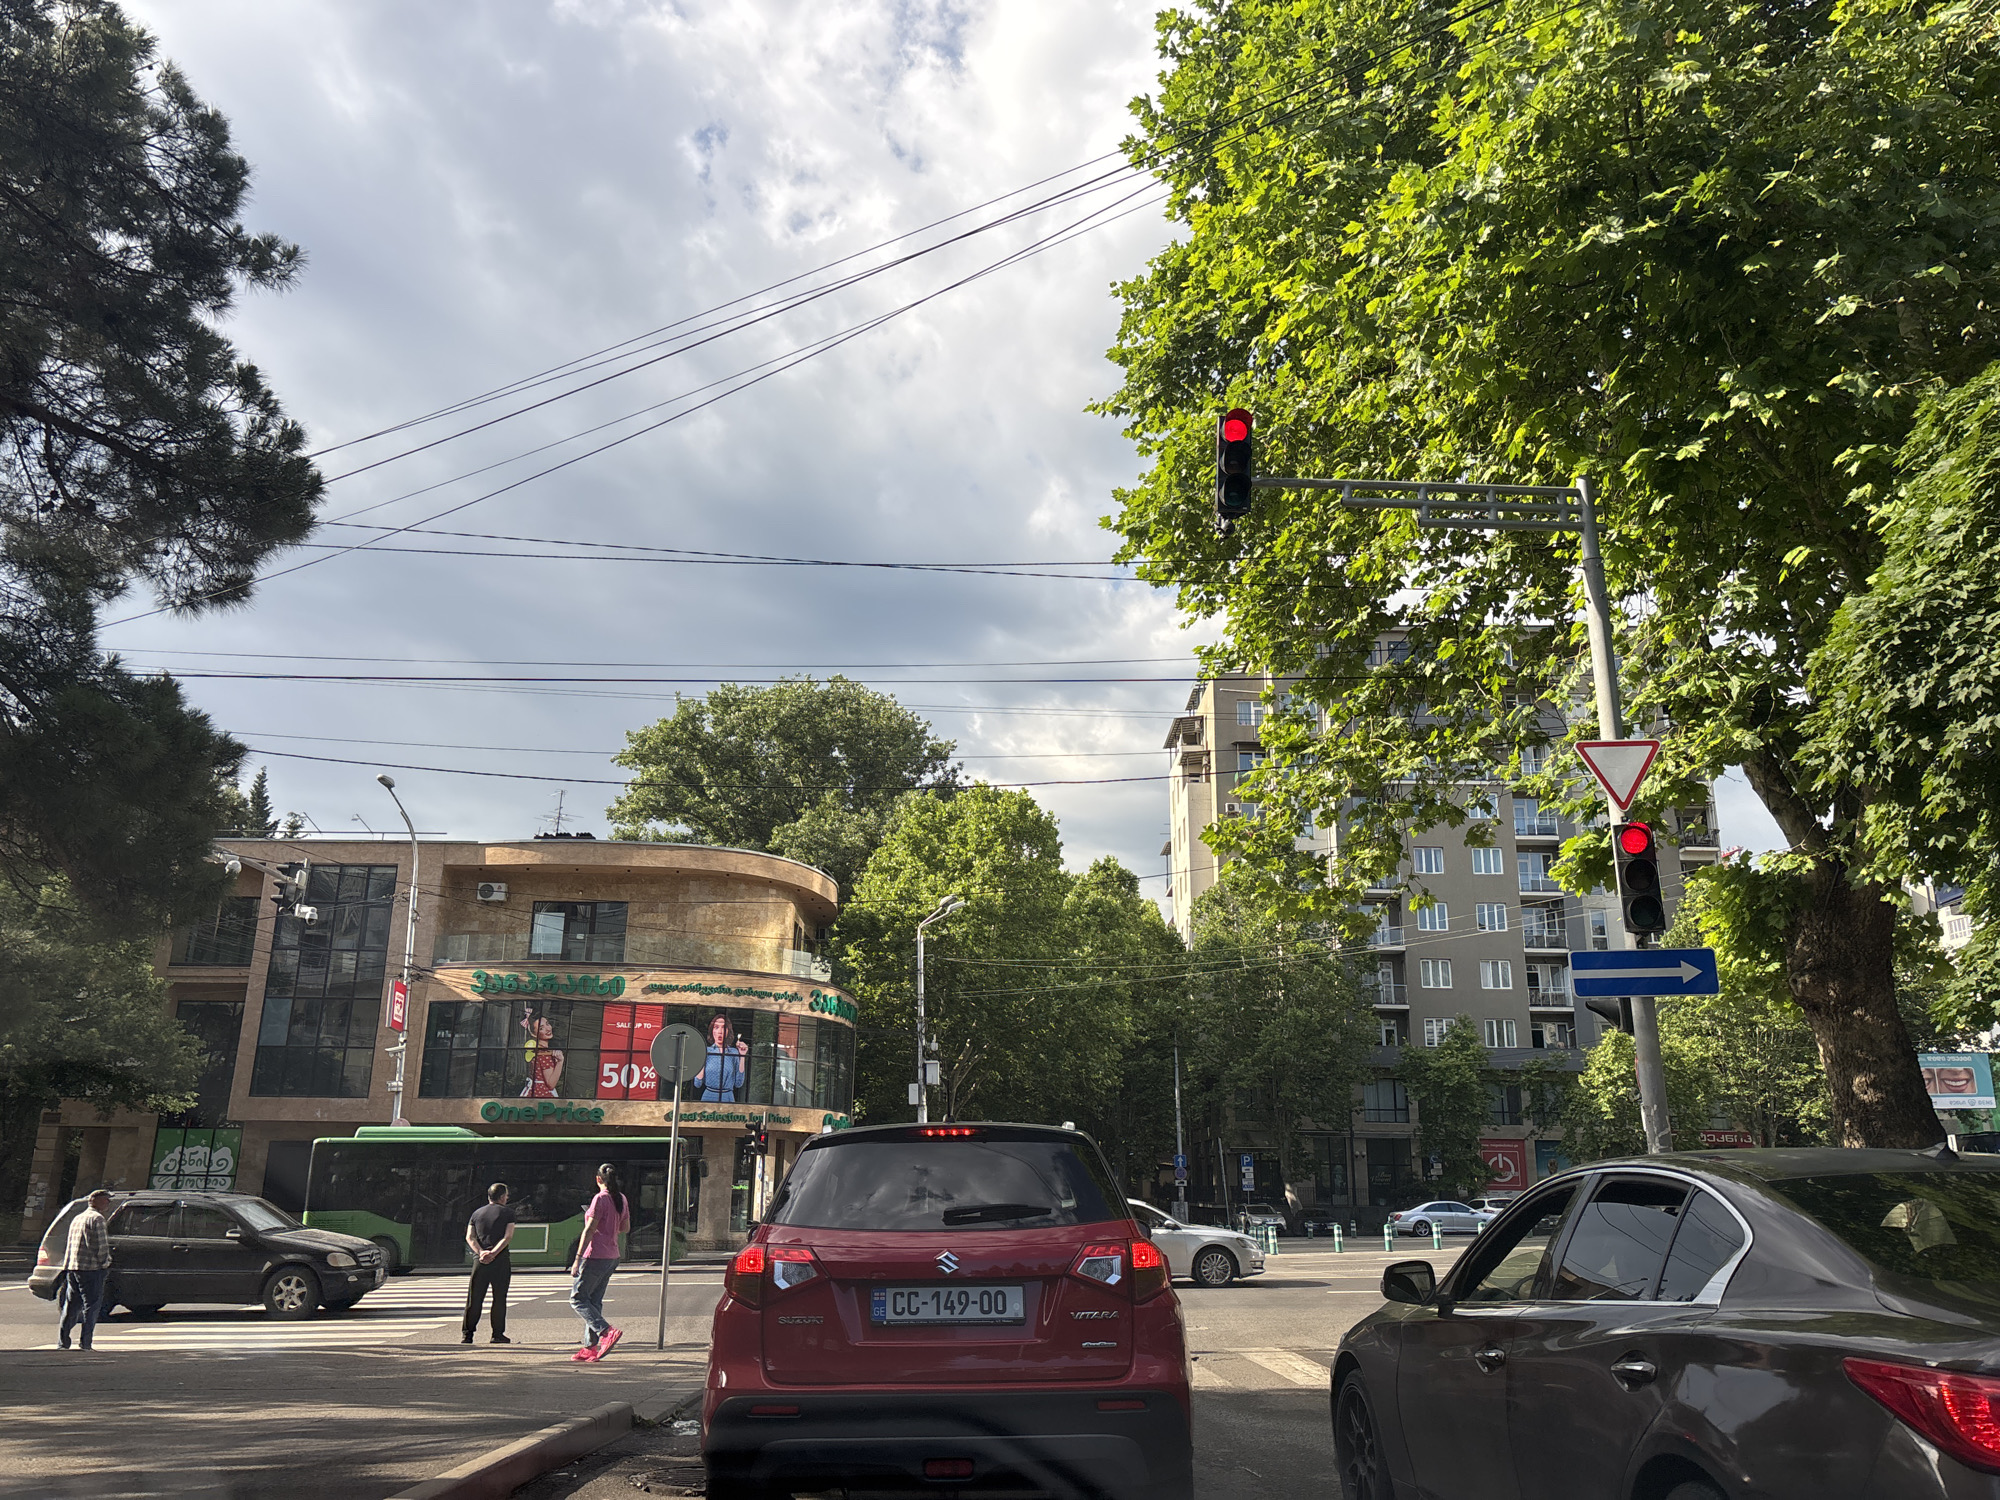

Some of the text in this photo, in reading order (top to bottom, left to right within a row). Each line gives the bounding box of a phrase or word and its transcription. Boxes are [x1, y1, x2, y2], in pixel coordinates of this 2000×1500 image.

[471, 969, 626, 995] ვანპრაისი
[640, 1081, 656, 1089] OFF
[481, 1101, 604, 1123] OnePrice
[1243, 1156, 1250, 1165] P
[892, 1290, 1007, 1316] CC-149-00
[873, 1307, 885, 1317] GE
[1070, 1310, 1119, 1319] VITARA
[778, 1316, 824, 1325] SUZUKI
